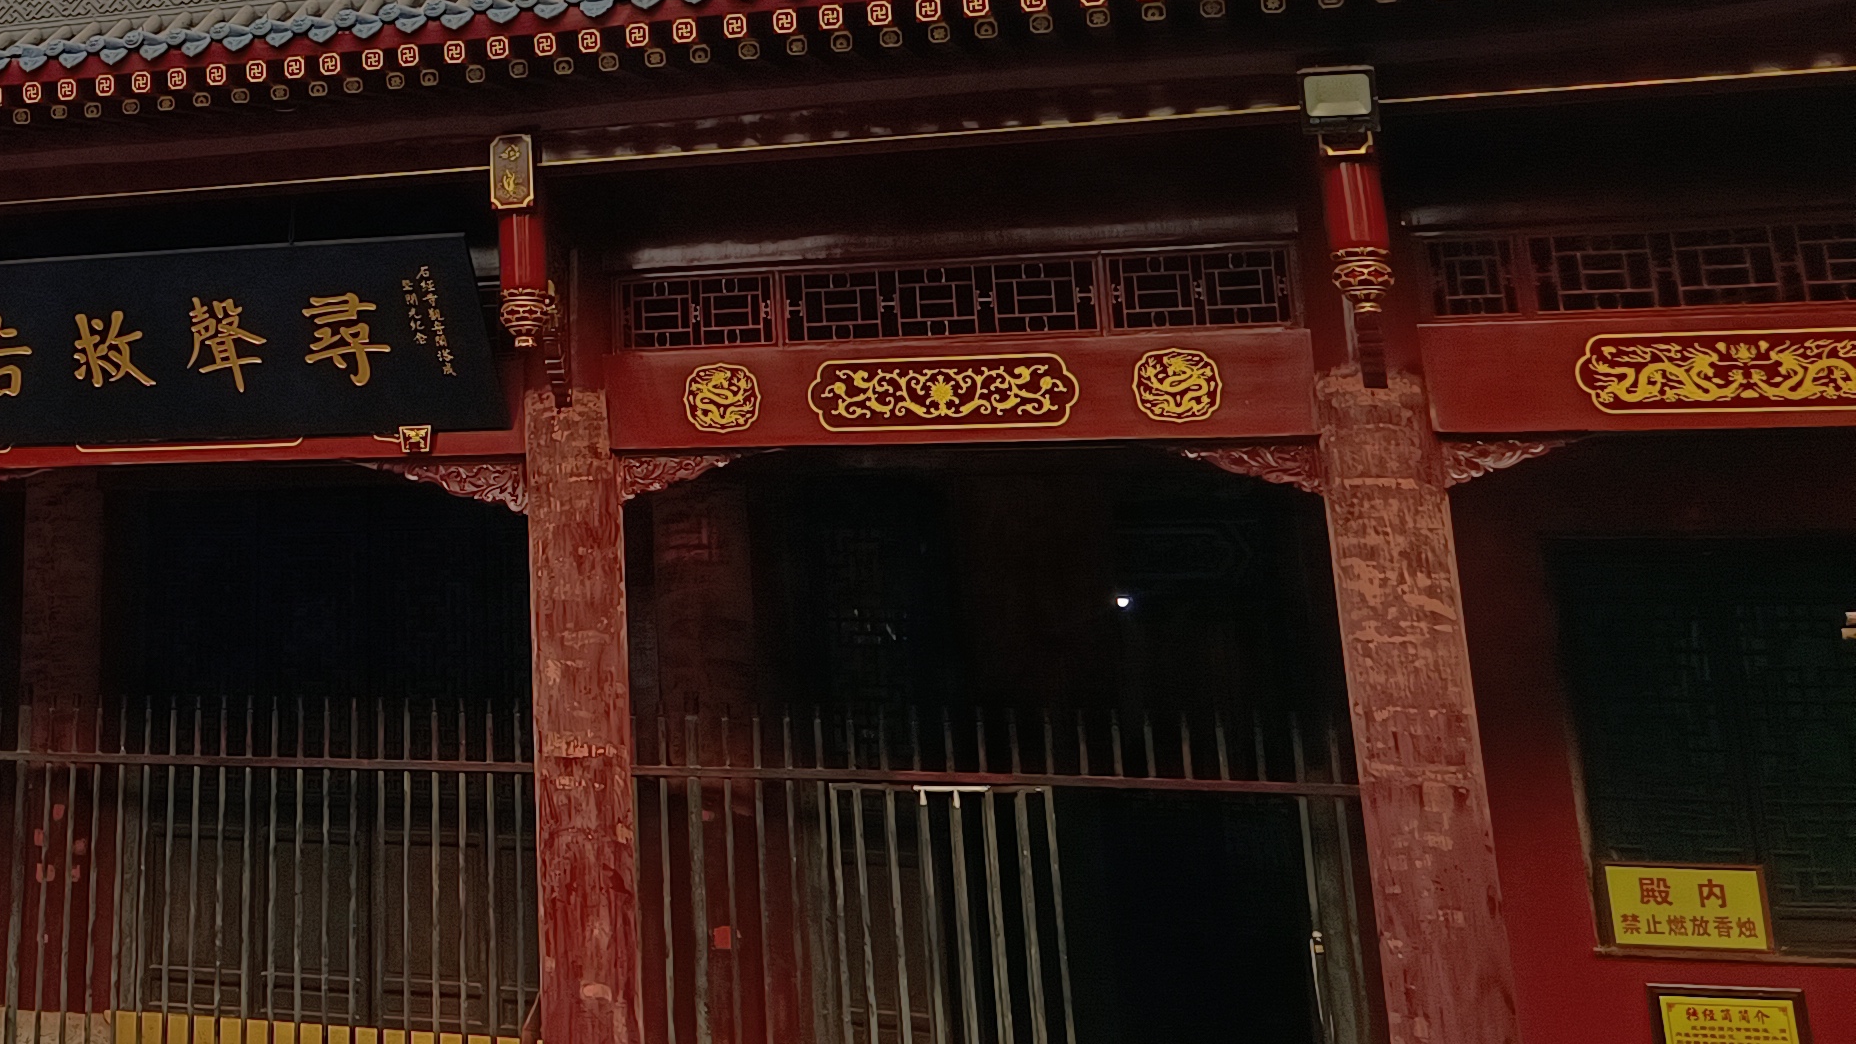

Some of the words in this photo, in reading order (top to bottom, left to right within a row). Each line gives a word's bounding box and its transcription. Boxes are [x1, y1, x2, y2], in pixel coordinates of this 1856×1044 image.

[1620, 913, 1760, 939] 禁止燃放香烛
